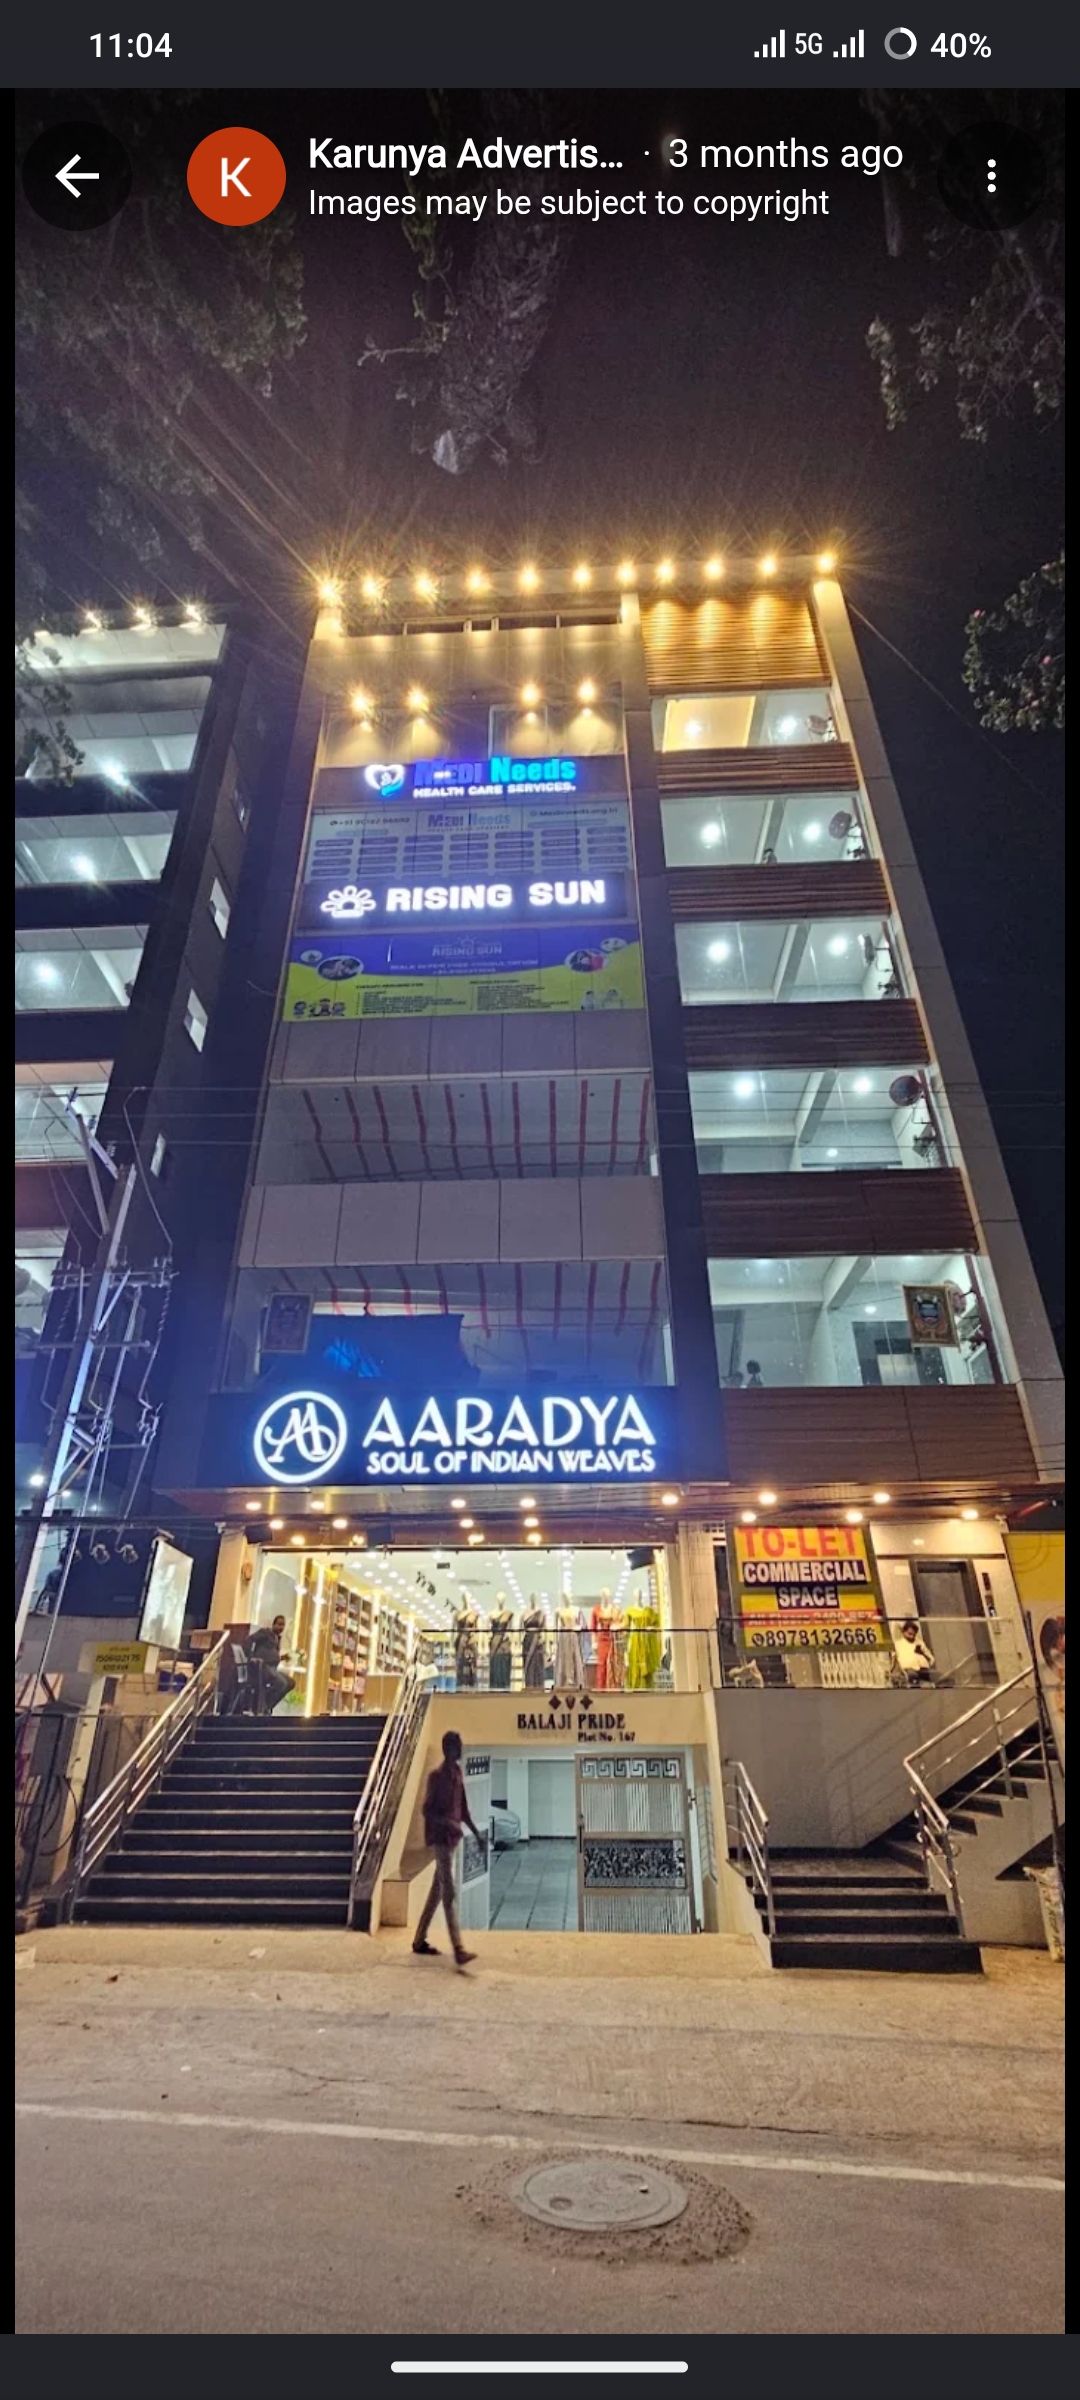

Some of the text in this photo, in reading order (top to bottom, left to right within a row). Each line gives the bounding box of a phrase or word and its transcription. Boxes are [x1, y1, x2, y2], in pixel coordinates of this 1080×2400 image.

[490, 756, 576, 782] Needs
[413, 787, 464, 798] HEALTH
[468, 784, 503, 796] CARE
[386, 880, 605, 912] RISING SUN
[362, 1395, 656, 1448] AARADYA
[367, 1449, 656, 1475] SOUL OF INDIAN WEAVES
[738, 1525, 859, 1558] TO-LET
[744, 1561, 866, 1583] COMMERCIAL
[777, 1586, 838, 1607] SPACE
[517, 1713, 626, 1730] BALAJI PRIDE
[578, 1731, 597, 1742] Plot
